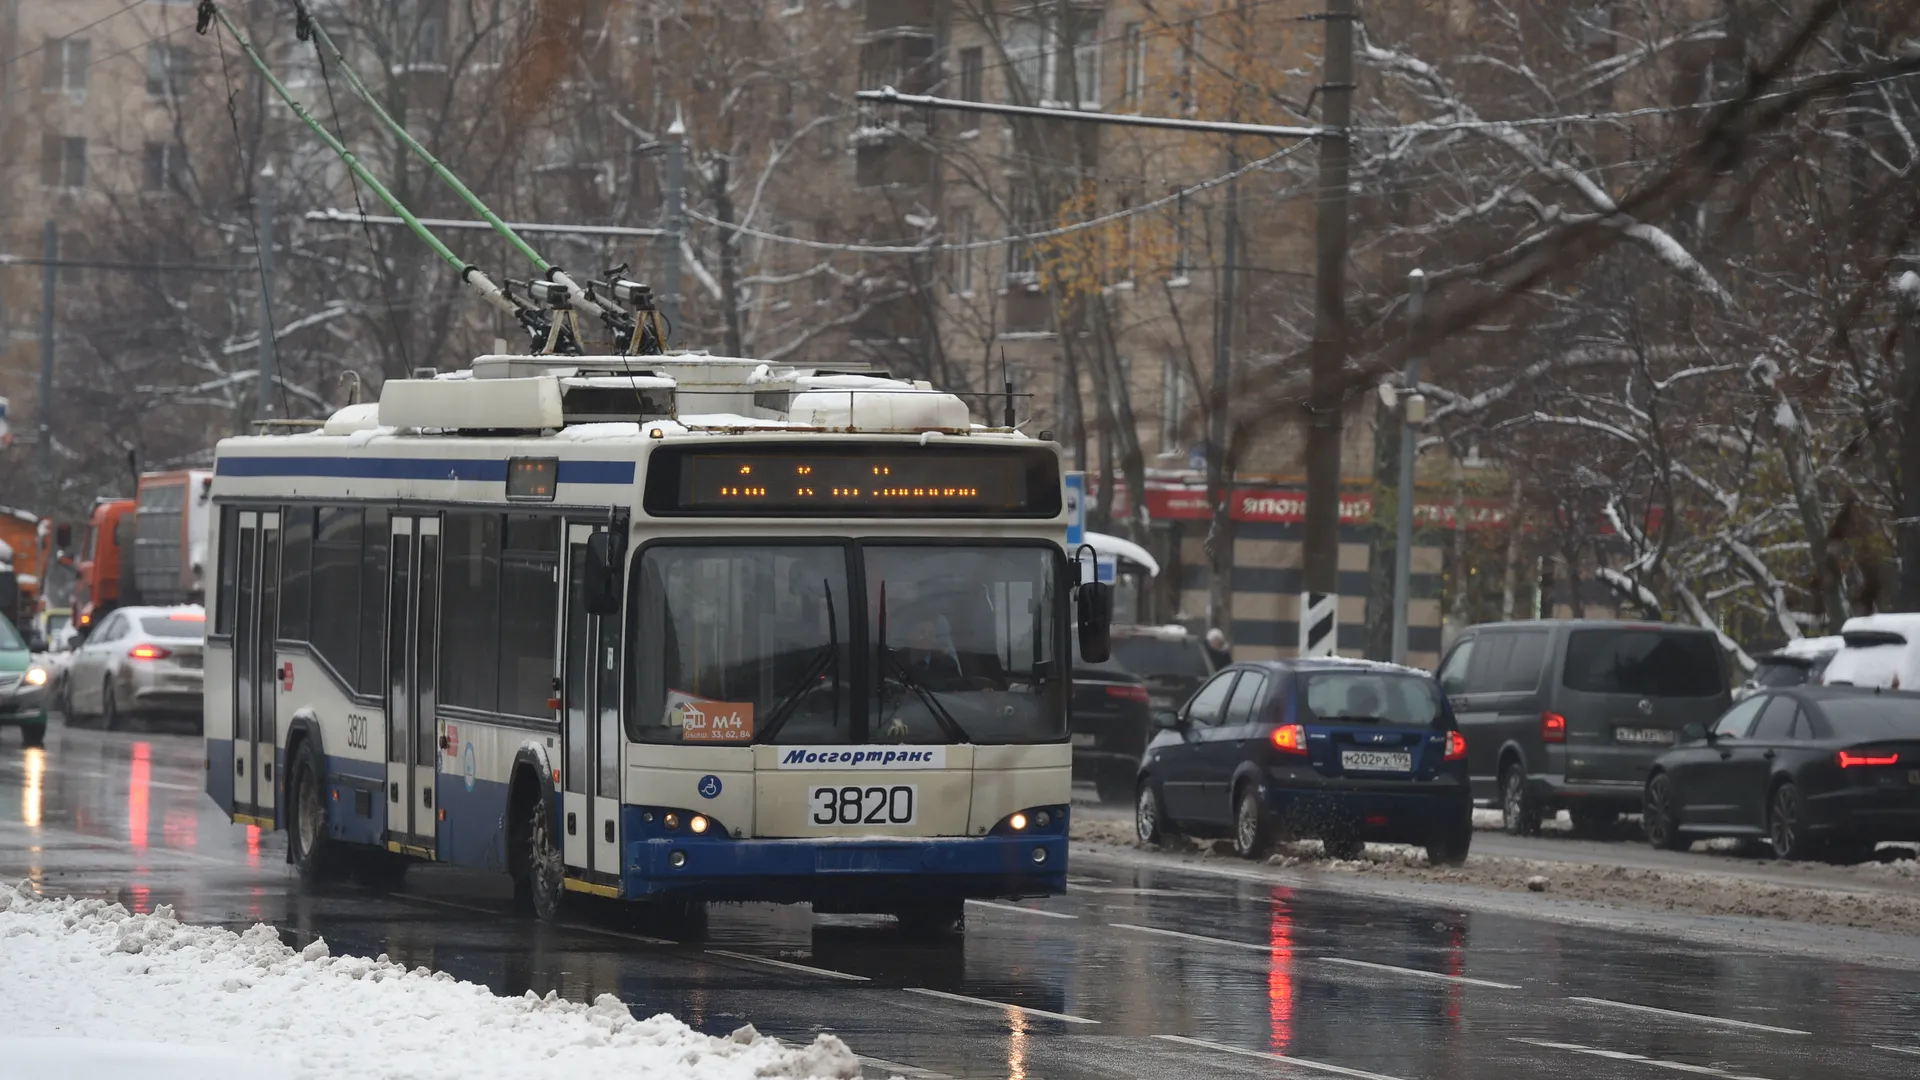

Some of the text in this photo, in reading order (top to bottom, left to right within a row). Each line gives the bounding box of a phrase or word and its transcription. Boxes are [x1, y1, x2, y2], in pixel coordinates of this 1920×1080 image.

[347, 714, 367, 750] 3820
[711, 730, 724, 739] 33,
[725, 730, 738, 739] 62,
[740, 730, 751, 738] 84
[782, 750, 933, 766] Мосгортранс
[813, 786, 913, 825] 3820
